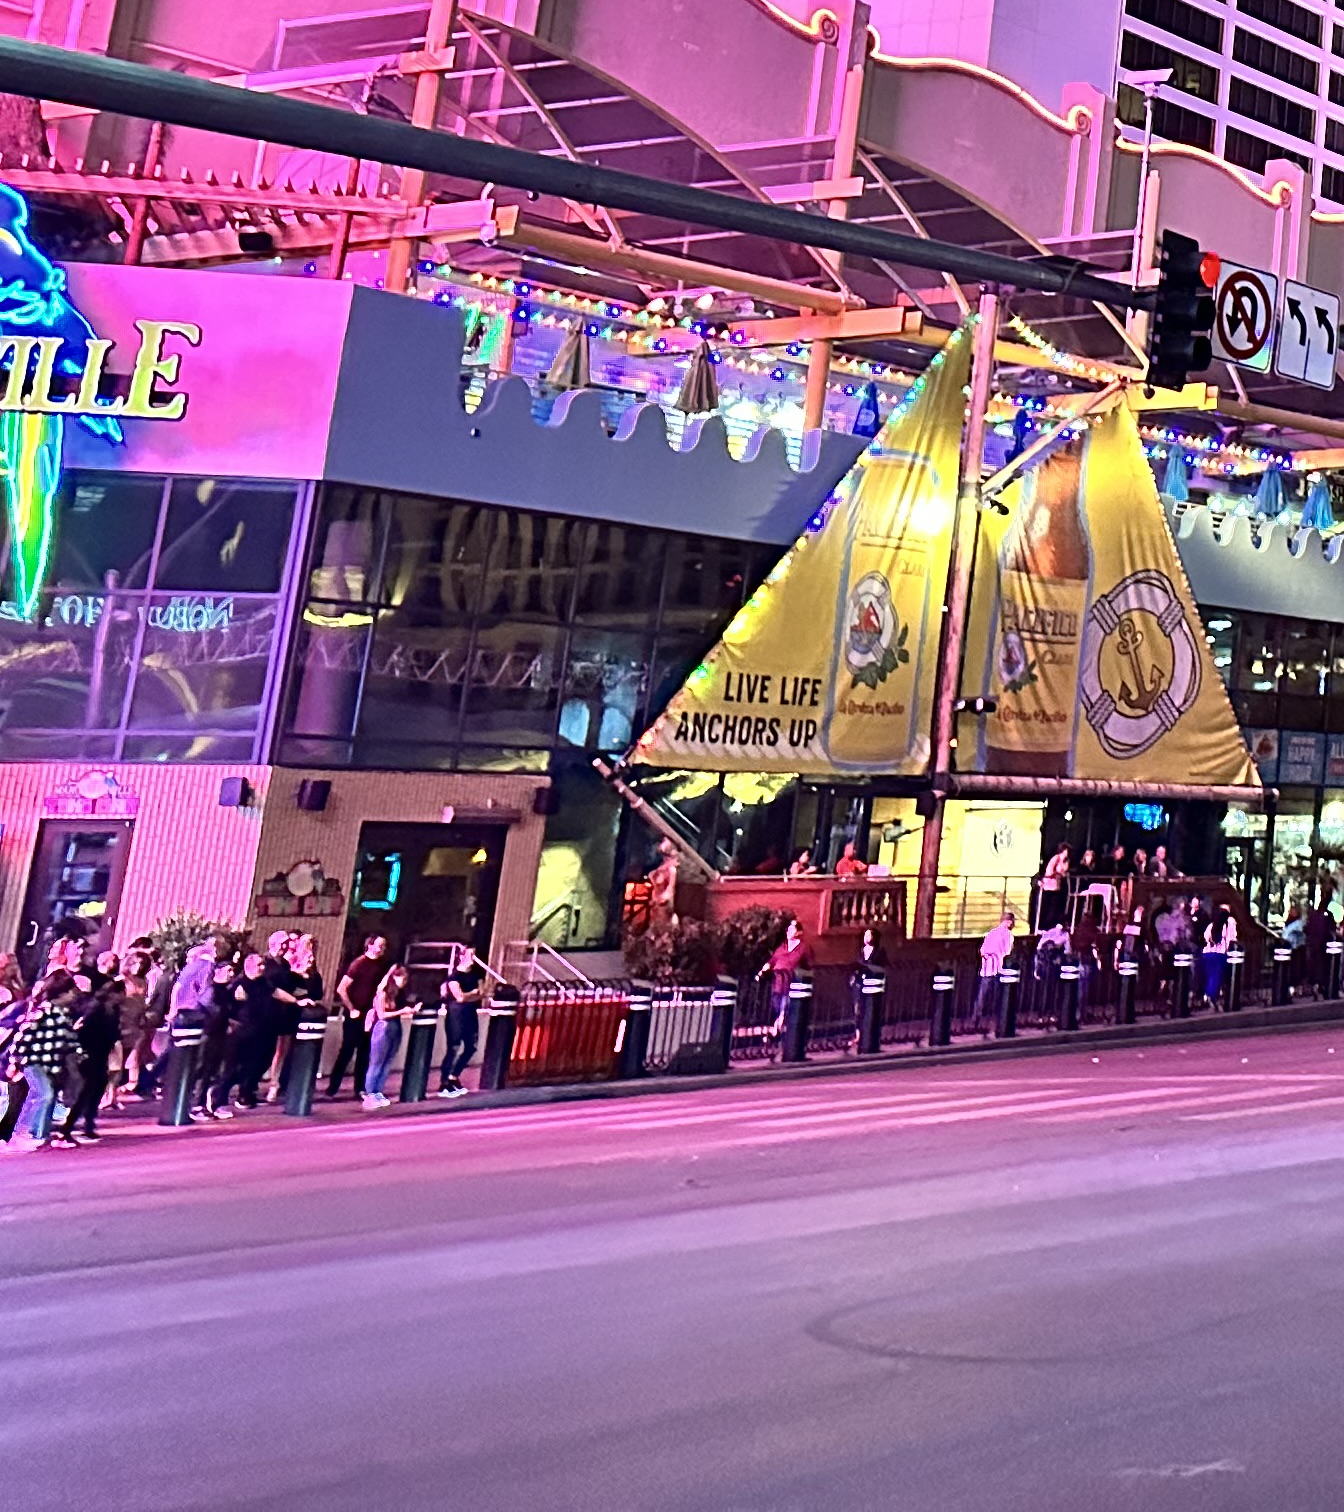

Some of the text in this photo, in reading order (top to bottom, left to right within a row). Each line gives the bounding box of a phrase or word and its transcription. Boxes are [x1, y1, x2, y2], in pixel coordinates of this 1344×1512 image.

[0, 319, 203, 420] ILLE
[723, 671, 823, 706] LIVE LIFE
[674, 711, 817, 748] ANCHORS UP
